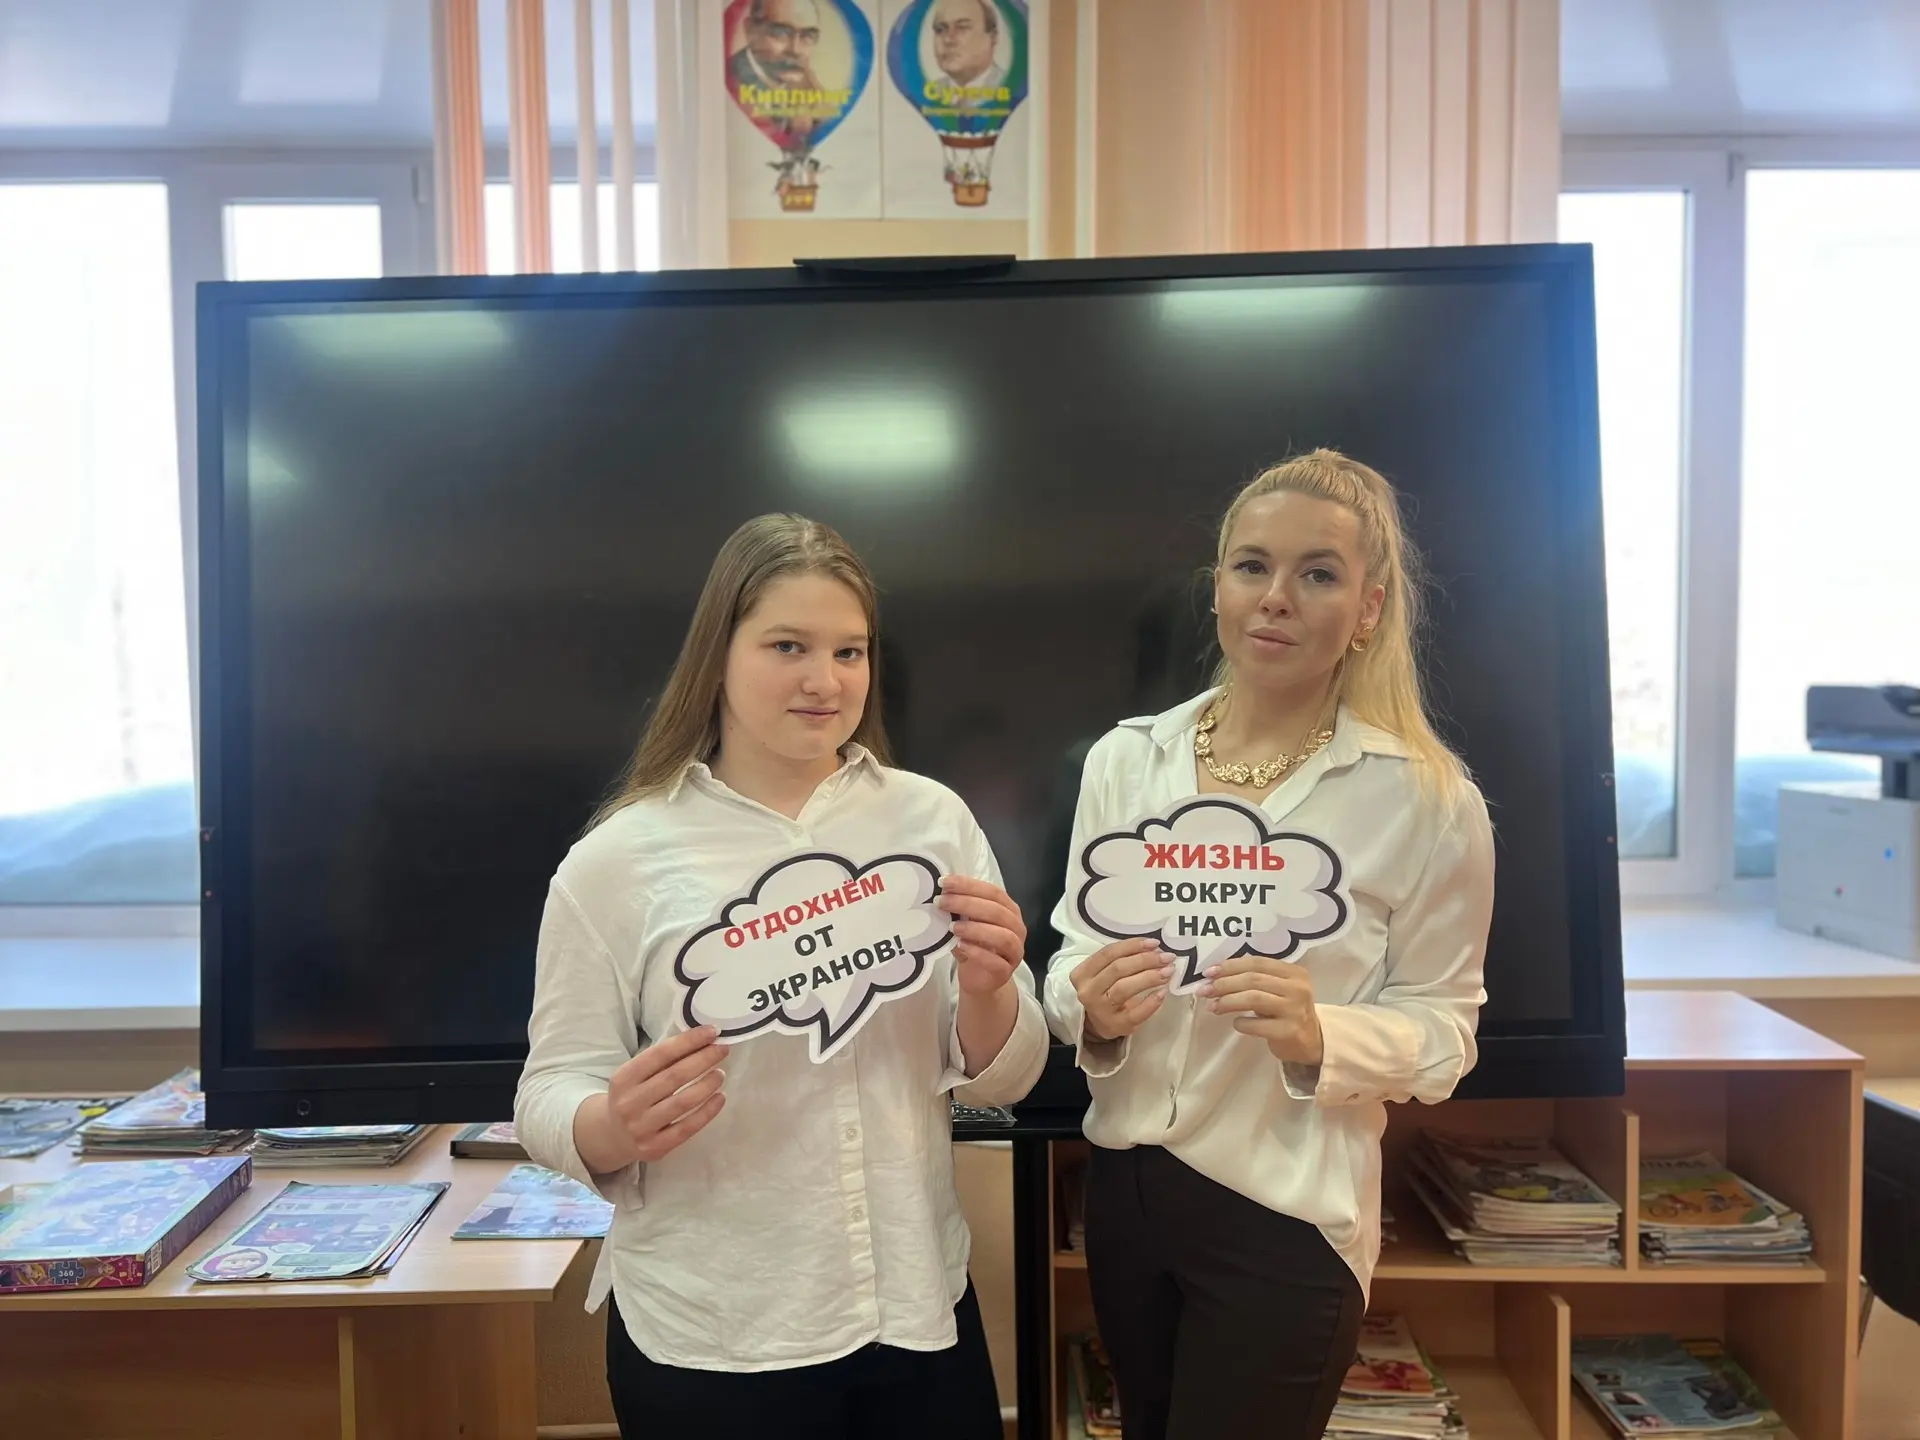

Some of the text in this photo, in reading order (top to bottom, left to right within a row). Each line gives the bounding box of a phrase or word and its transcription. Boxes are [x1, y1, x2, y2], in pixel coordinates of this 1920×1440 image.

[1143, 843, 1285, 871] ЖИЗНЬ
[1155, 882, 1276, 905] ВОКРУГ
[723, 873, 886, 949] ОТДОХНЁМ
[793, 924, 834, 957] ОТ
[1178, 916, 1252, 938] НАС!
[746, 934, 907, 1012] ЭКРАНОВ!
